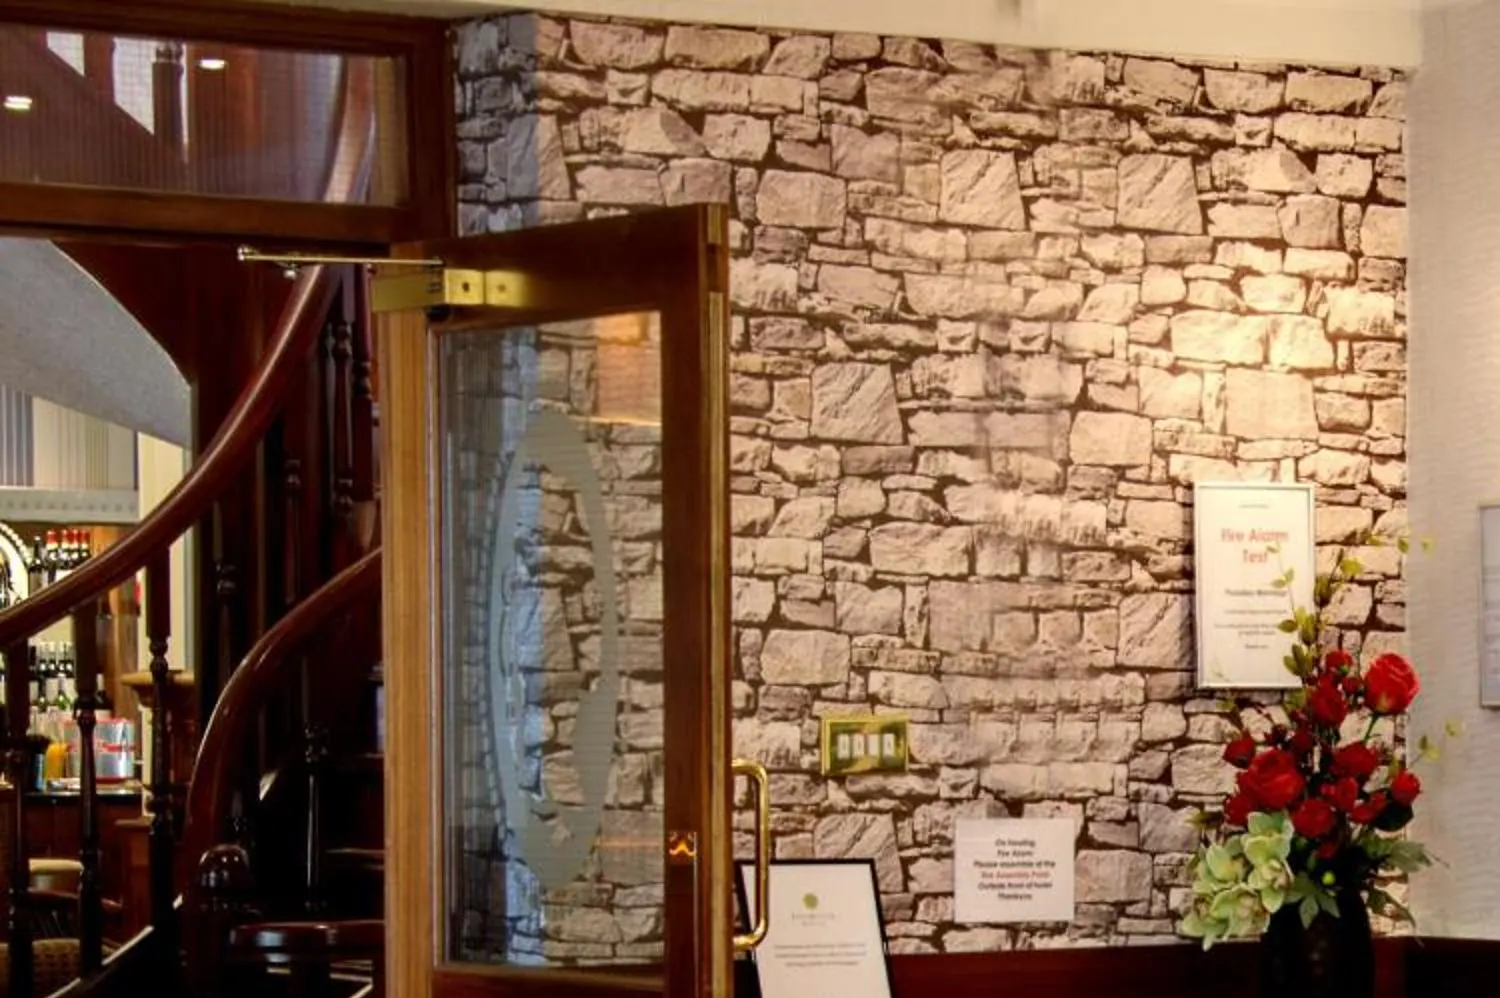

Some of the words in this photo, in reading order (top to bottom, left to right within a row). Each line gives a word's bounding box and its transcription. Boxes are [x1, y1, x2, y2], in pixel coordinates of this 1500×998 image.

[1221, 528, 1244, 542] Fire
[1248, 528, 1288, 542] Alarm
[1243, 549, 1268, 563] Test
[974, 860, 997, 868] Please
